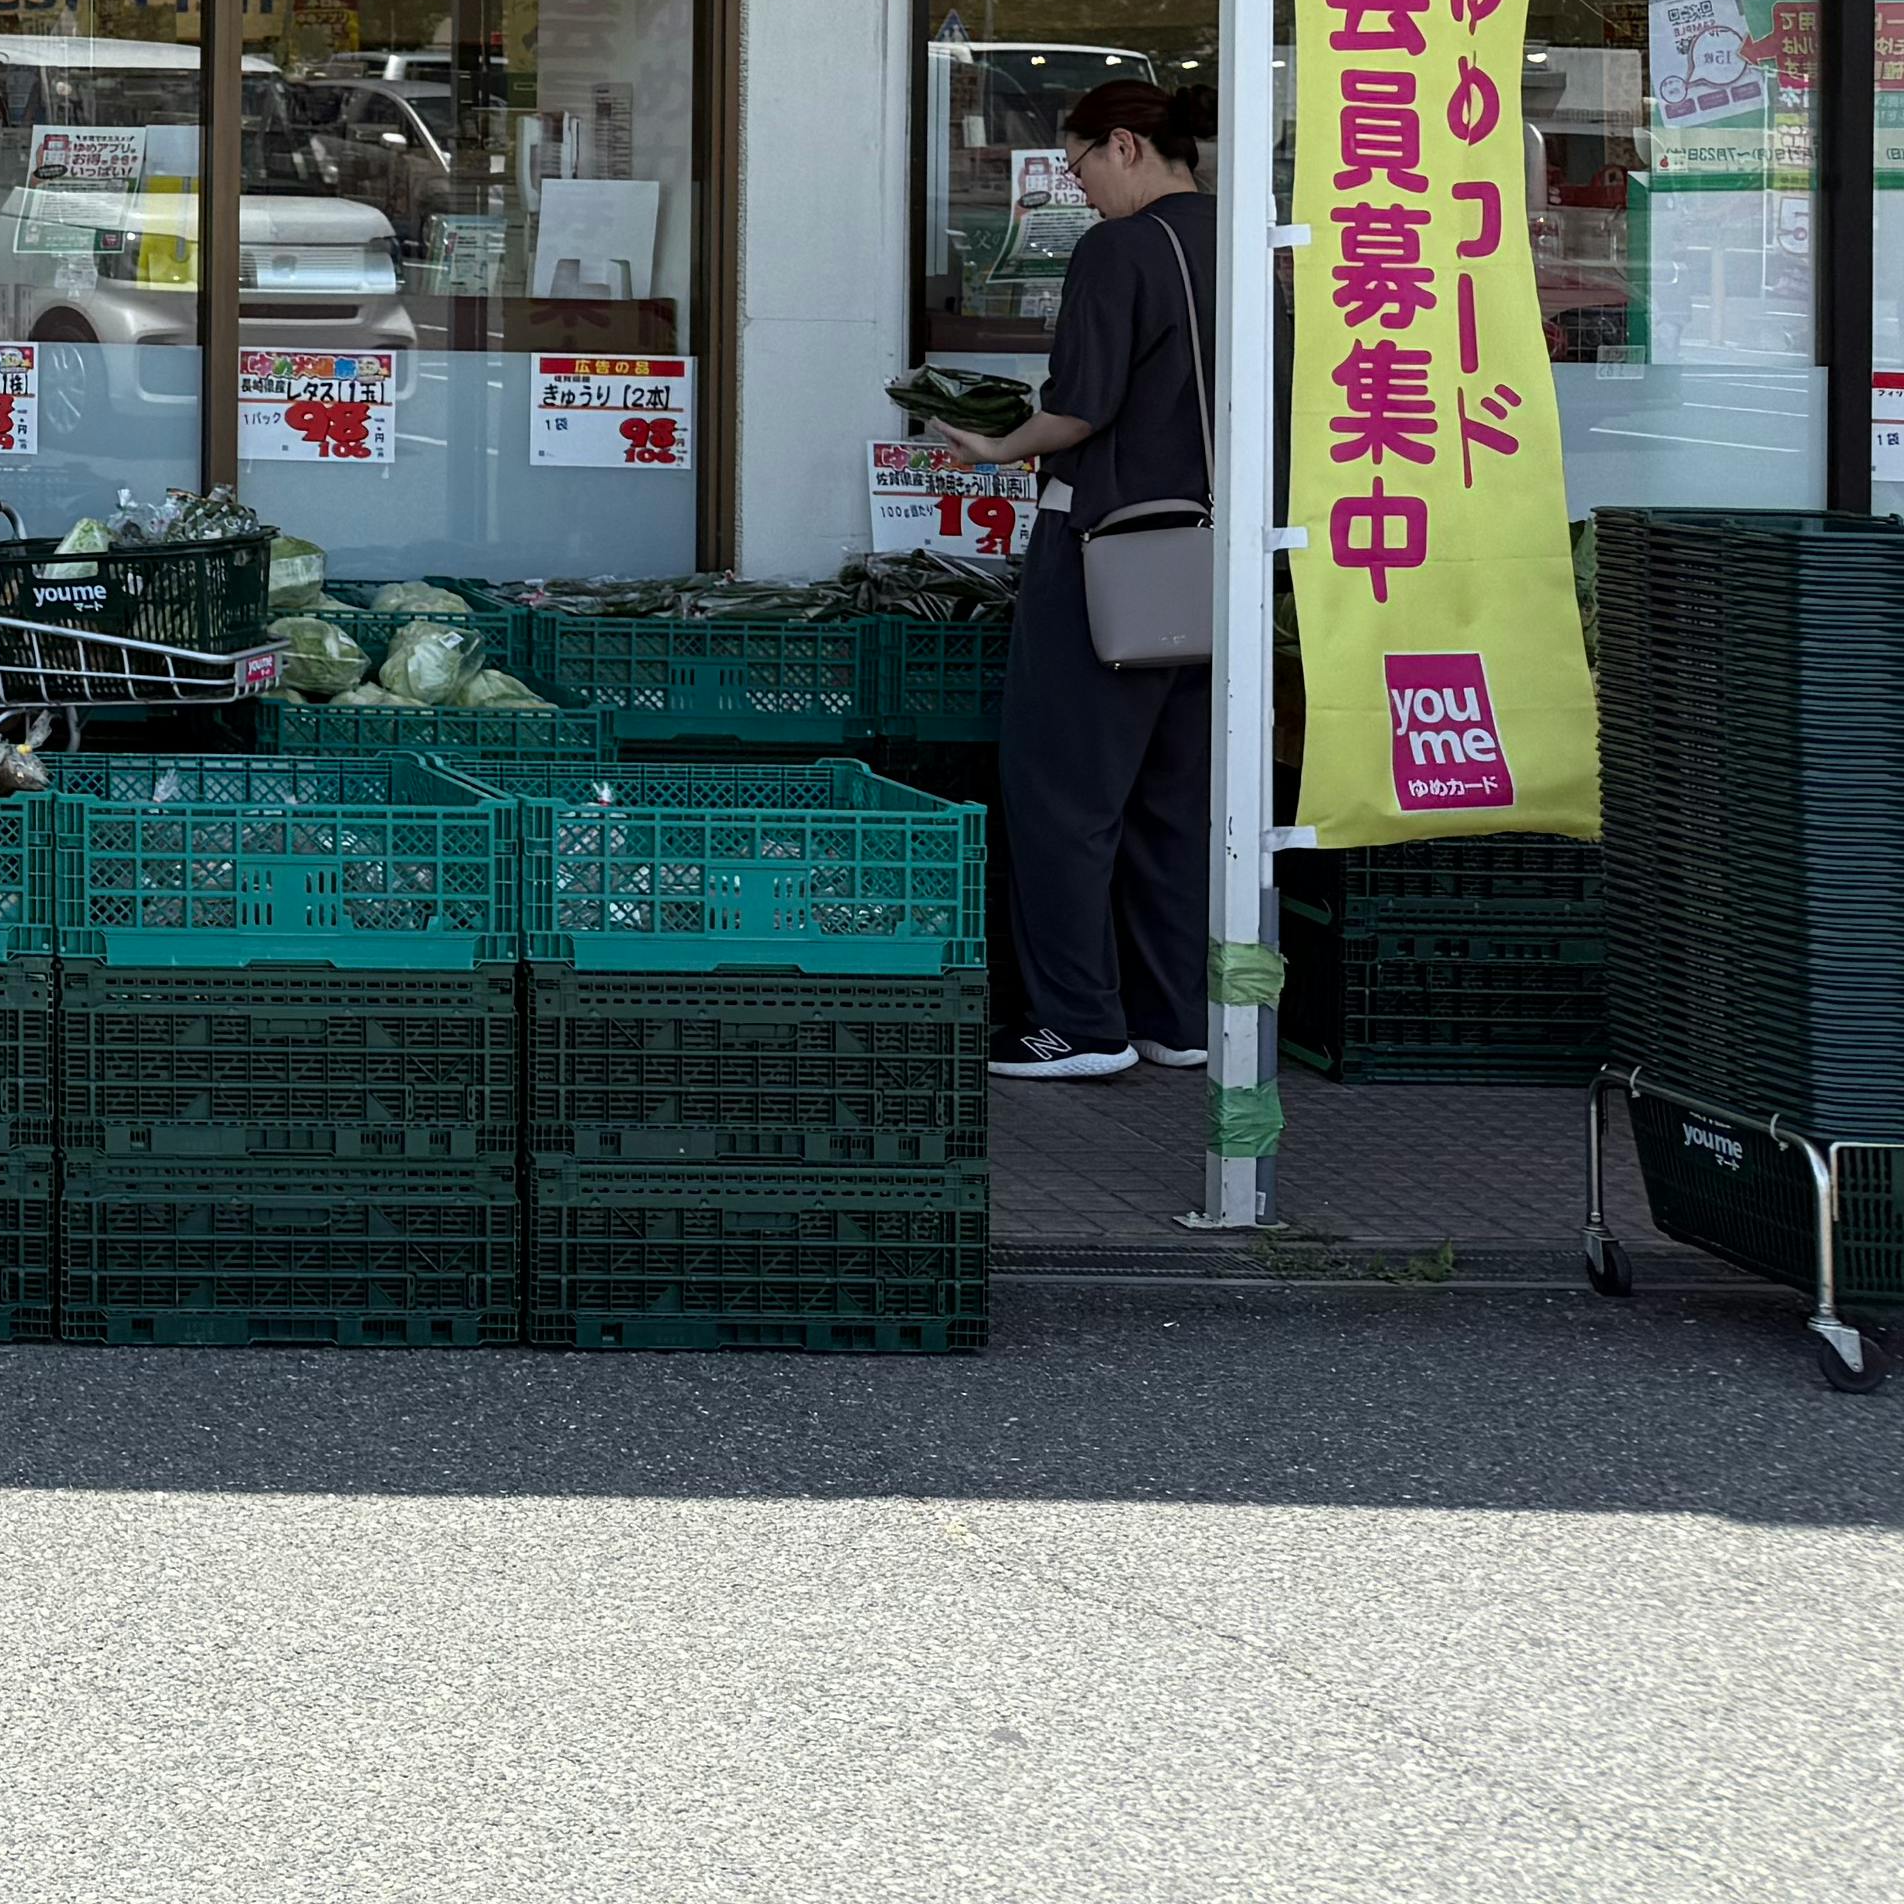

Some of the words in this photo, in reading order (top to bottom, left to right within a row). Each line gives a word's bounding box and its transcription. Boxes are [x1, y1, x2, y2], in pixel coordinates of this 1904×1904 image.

[574, 359, 651, 375] 広告の品
[284, 402, 373, 443] 98
[618, 417, 678, 448] 98
[317, 441, 372, 458] 106
[623, 447, 677, 464] 106
[934, 496, 1016, 536] 19
[32, 582, 107, 607] youme
[1390, 686, 1482, 736] you
[1408, 727, 1497, 765] me
[1407, 775, 1499, 798] ゆめカード
[1682, 1122, 1743, 1160] youme
